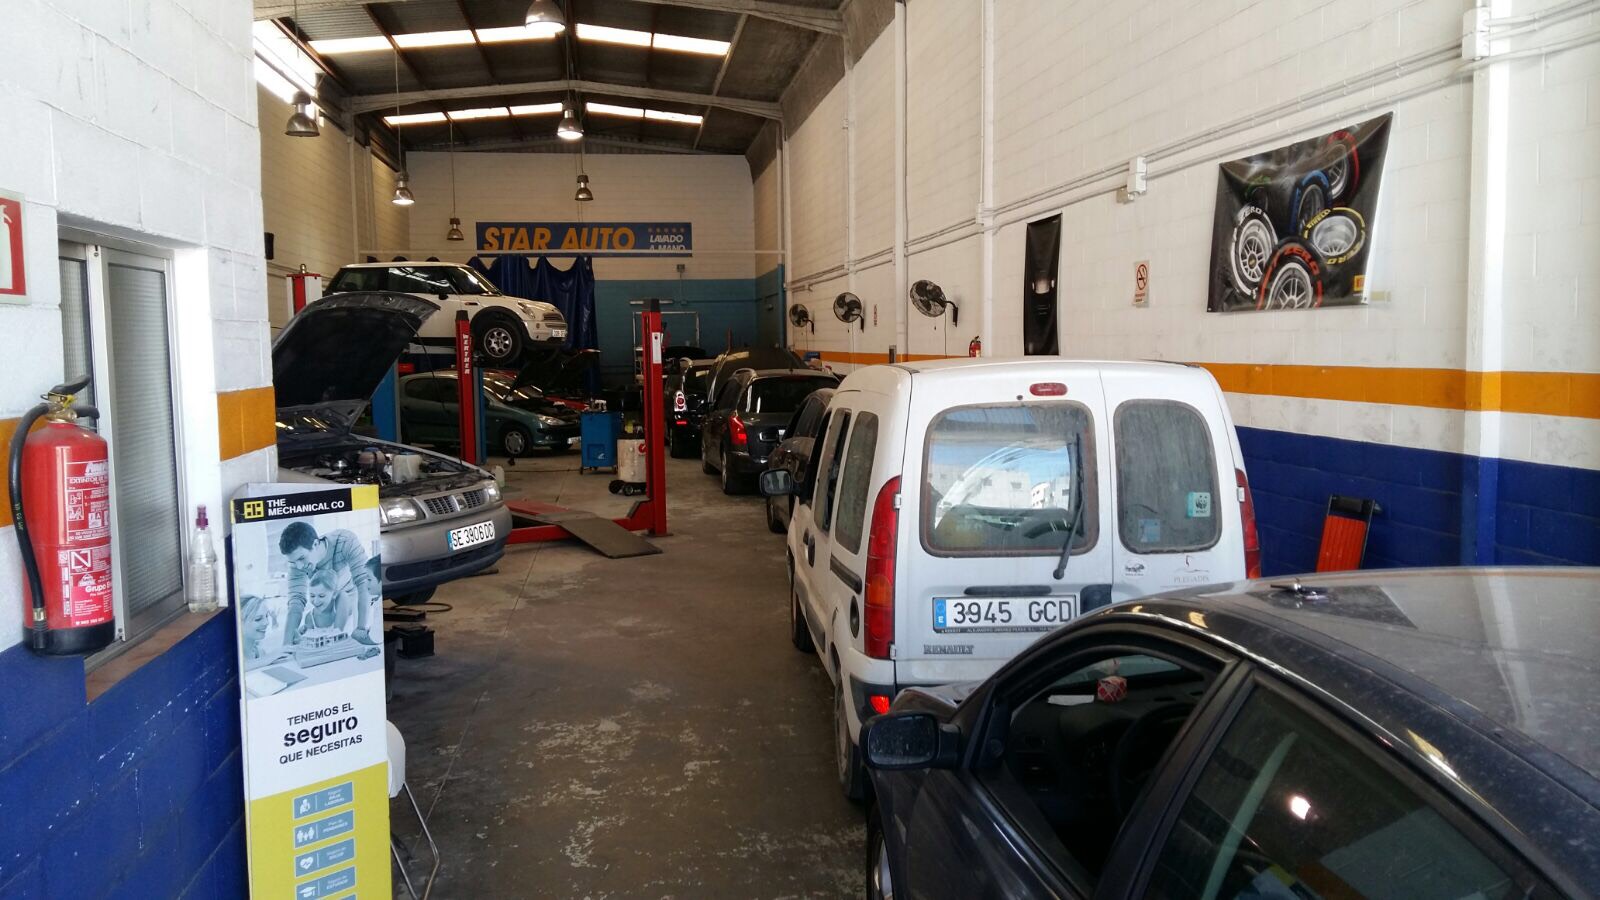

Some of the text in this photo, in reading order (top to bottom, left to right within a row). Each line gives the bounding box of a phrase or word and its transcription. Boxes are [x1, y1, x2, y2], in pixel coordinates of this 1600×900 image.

[483, 226, 635, 250] STAR AUTO
[649, 234, 684, 243] LAVADO
[266, 498, 287, 508] THE
[267, 500, 345, 517] MECHANICAL CO
[452, 530, 464, 547] SE
[85, 584, 106, 593] Grupo
[953, 600, 1072, 624] 3945 GCD
[923, 644, 974, 655] RENAULT
[287, 702, 354, 726] TENEMOS EL
[283, 716, 358, 747] seguro
[279, 734, 363, 765] QUE NECESITAS
